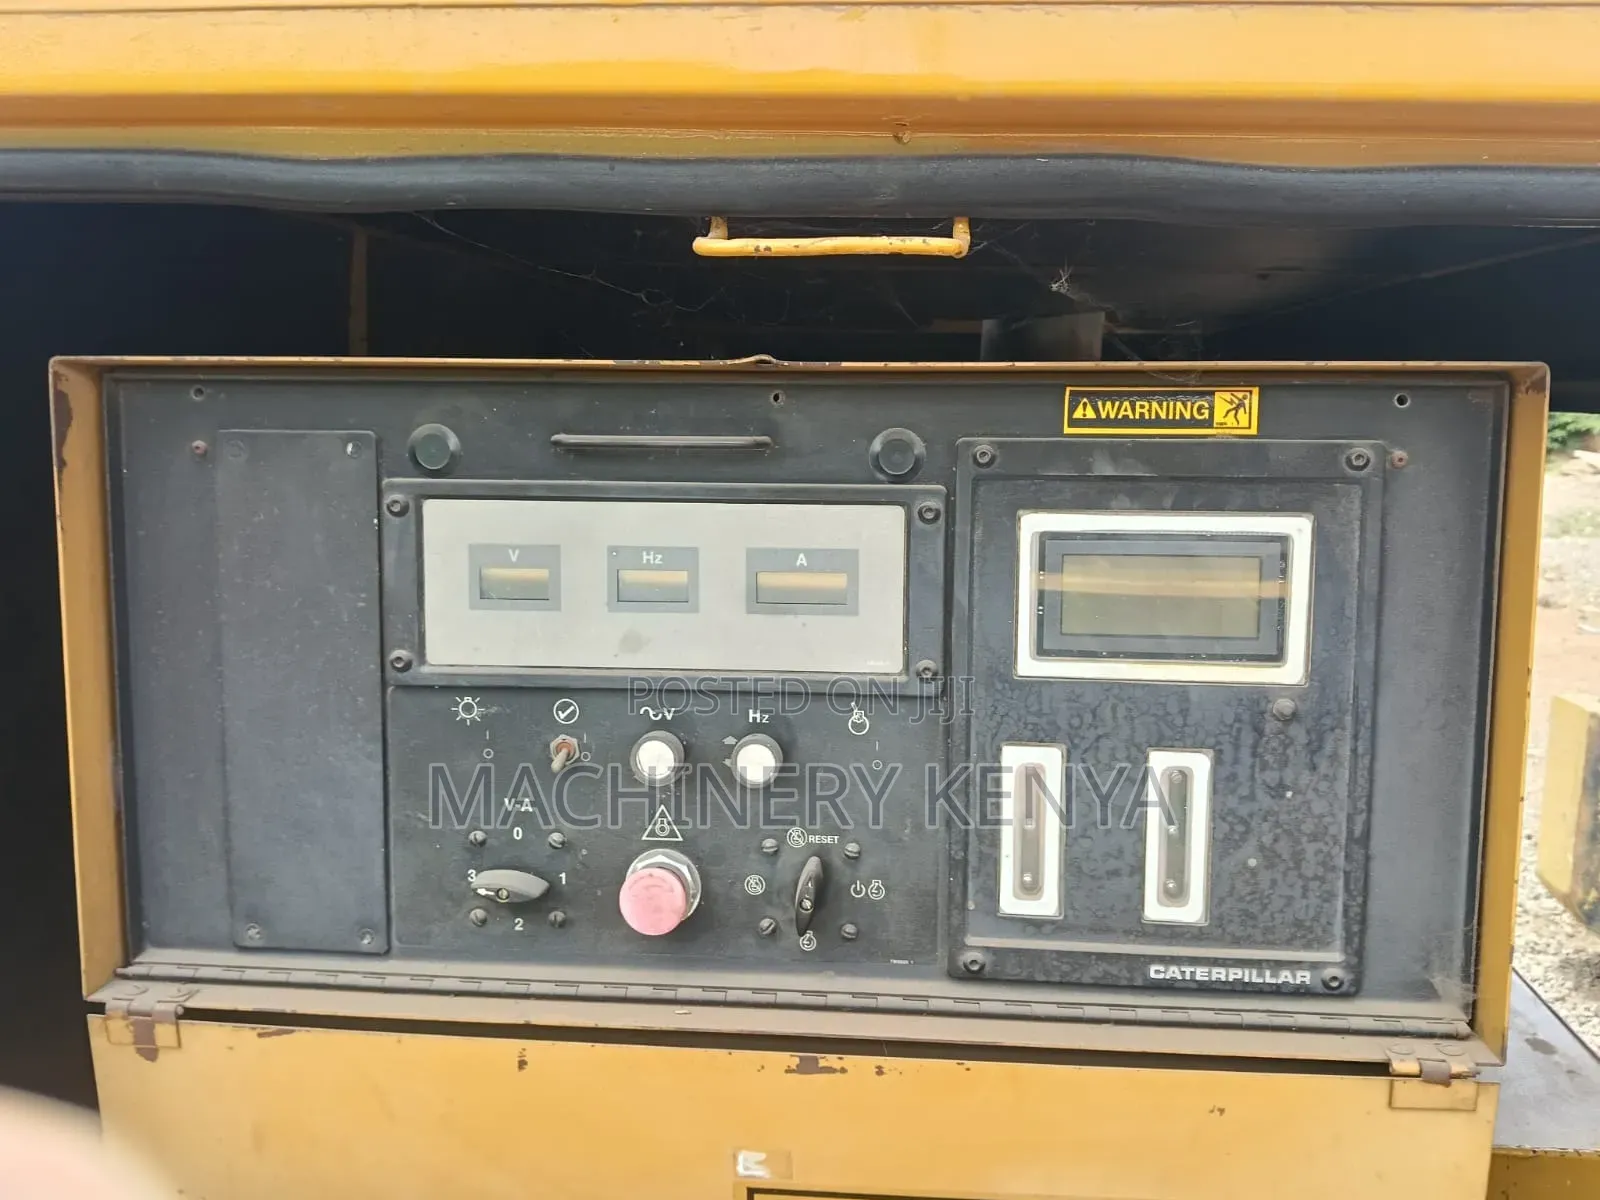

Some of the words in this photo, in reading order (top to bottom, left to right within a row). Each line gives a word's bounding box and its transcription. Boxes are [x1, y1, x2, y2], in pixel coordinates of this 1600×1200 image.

[1098, 399, 1210, 421] WARNING
[508, 549, 520, 562] V
[642, 551, 663, 565] Hz
[796, 553, 807, 567] A
[748, 709, 770, 723] Hz
[503, 797, 533, 812] V-A
[513, 827, 523, 840] 0
[808, 834, 840, 844] RESET
[467, 869, 477, 882] 3
[558, 872, 567, 885] 1
[514, 917, 524, 931] 2
[1149, 962, 1312, 986] CATERPILLAR
